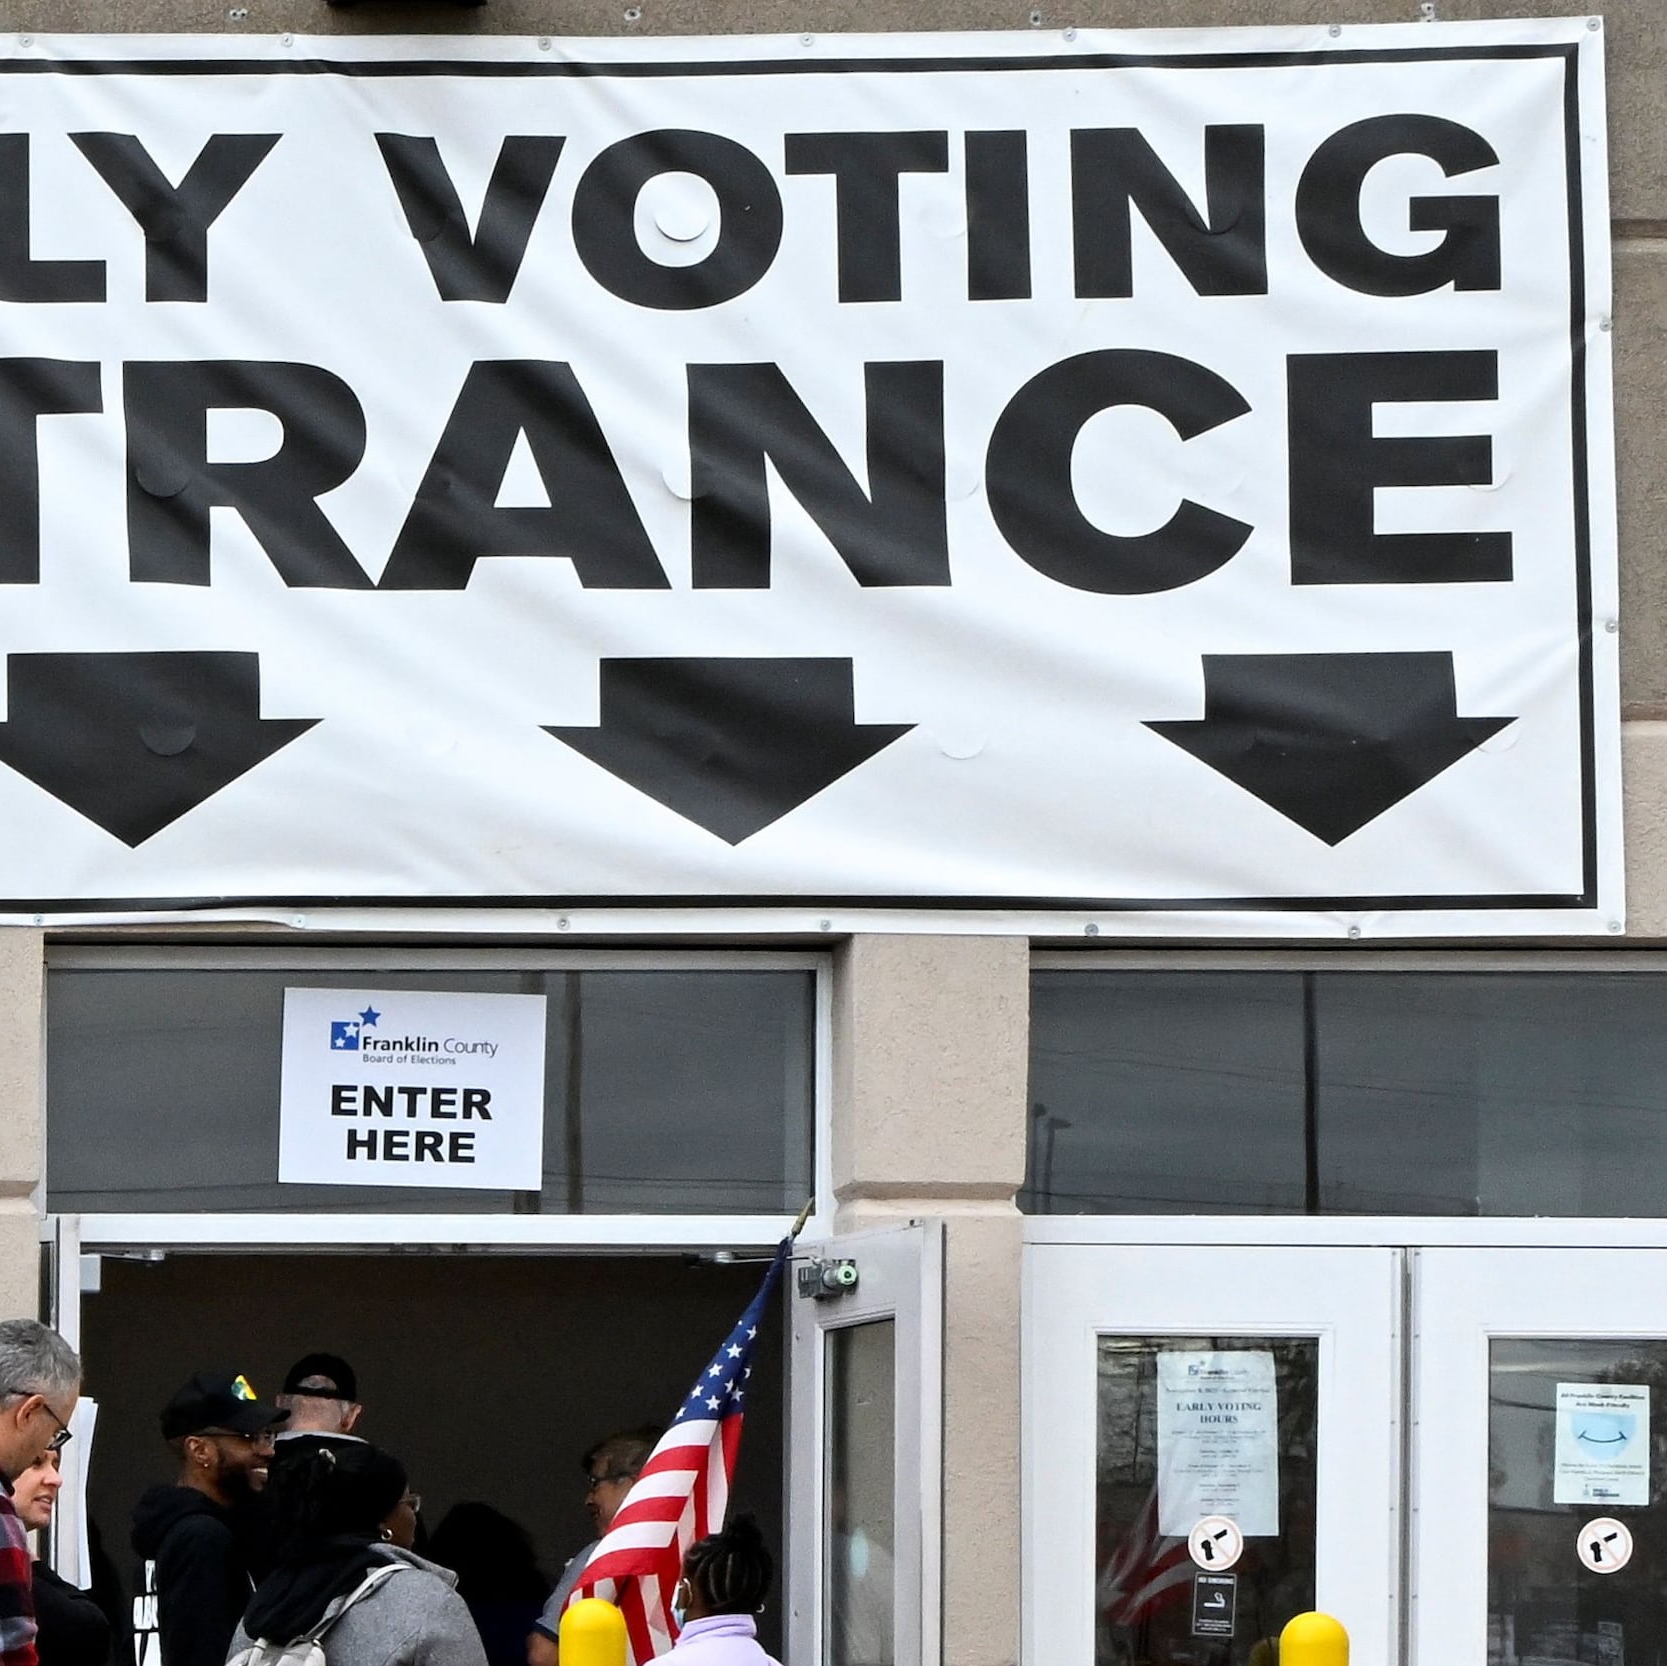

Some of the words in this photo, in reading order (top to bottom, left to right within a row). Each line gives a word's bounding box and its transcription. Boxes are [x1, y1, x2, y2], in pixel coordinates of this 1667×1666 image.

[374, 112, 1502, 311] VOTING
[362, 1036, 439, 1053] Franklin
[443, 1038, 499, 1059] County
[362, 1053, 394, 1064] Board
[396, 1054, 408, 1064] of
[410, 1054, 457, 1066] Elections
[330, 1084, 493, 1121] ENTER
[346, 1128, 476, 1164] HERE
